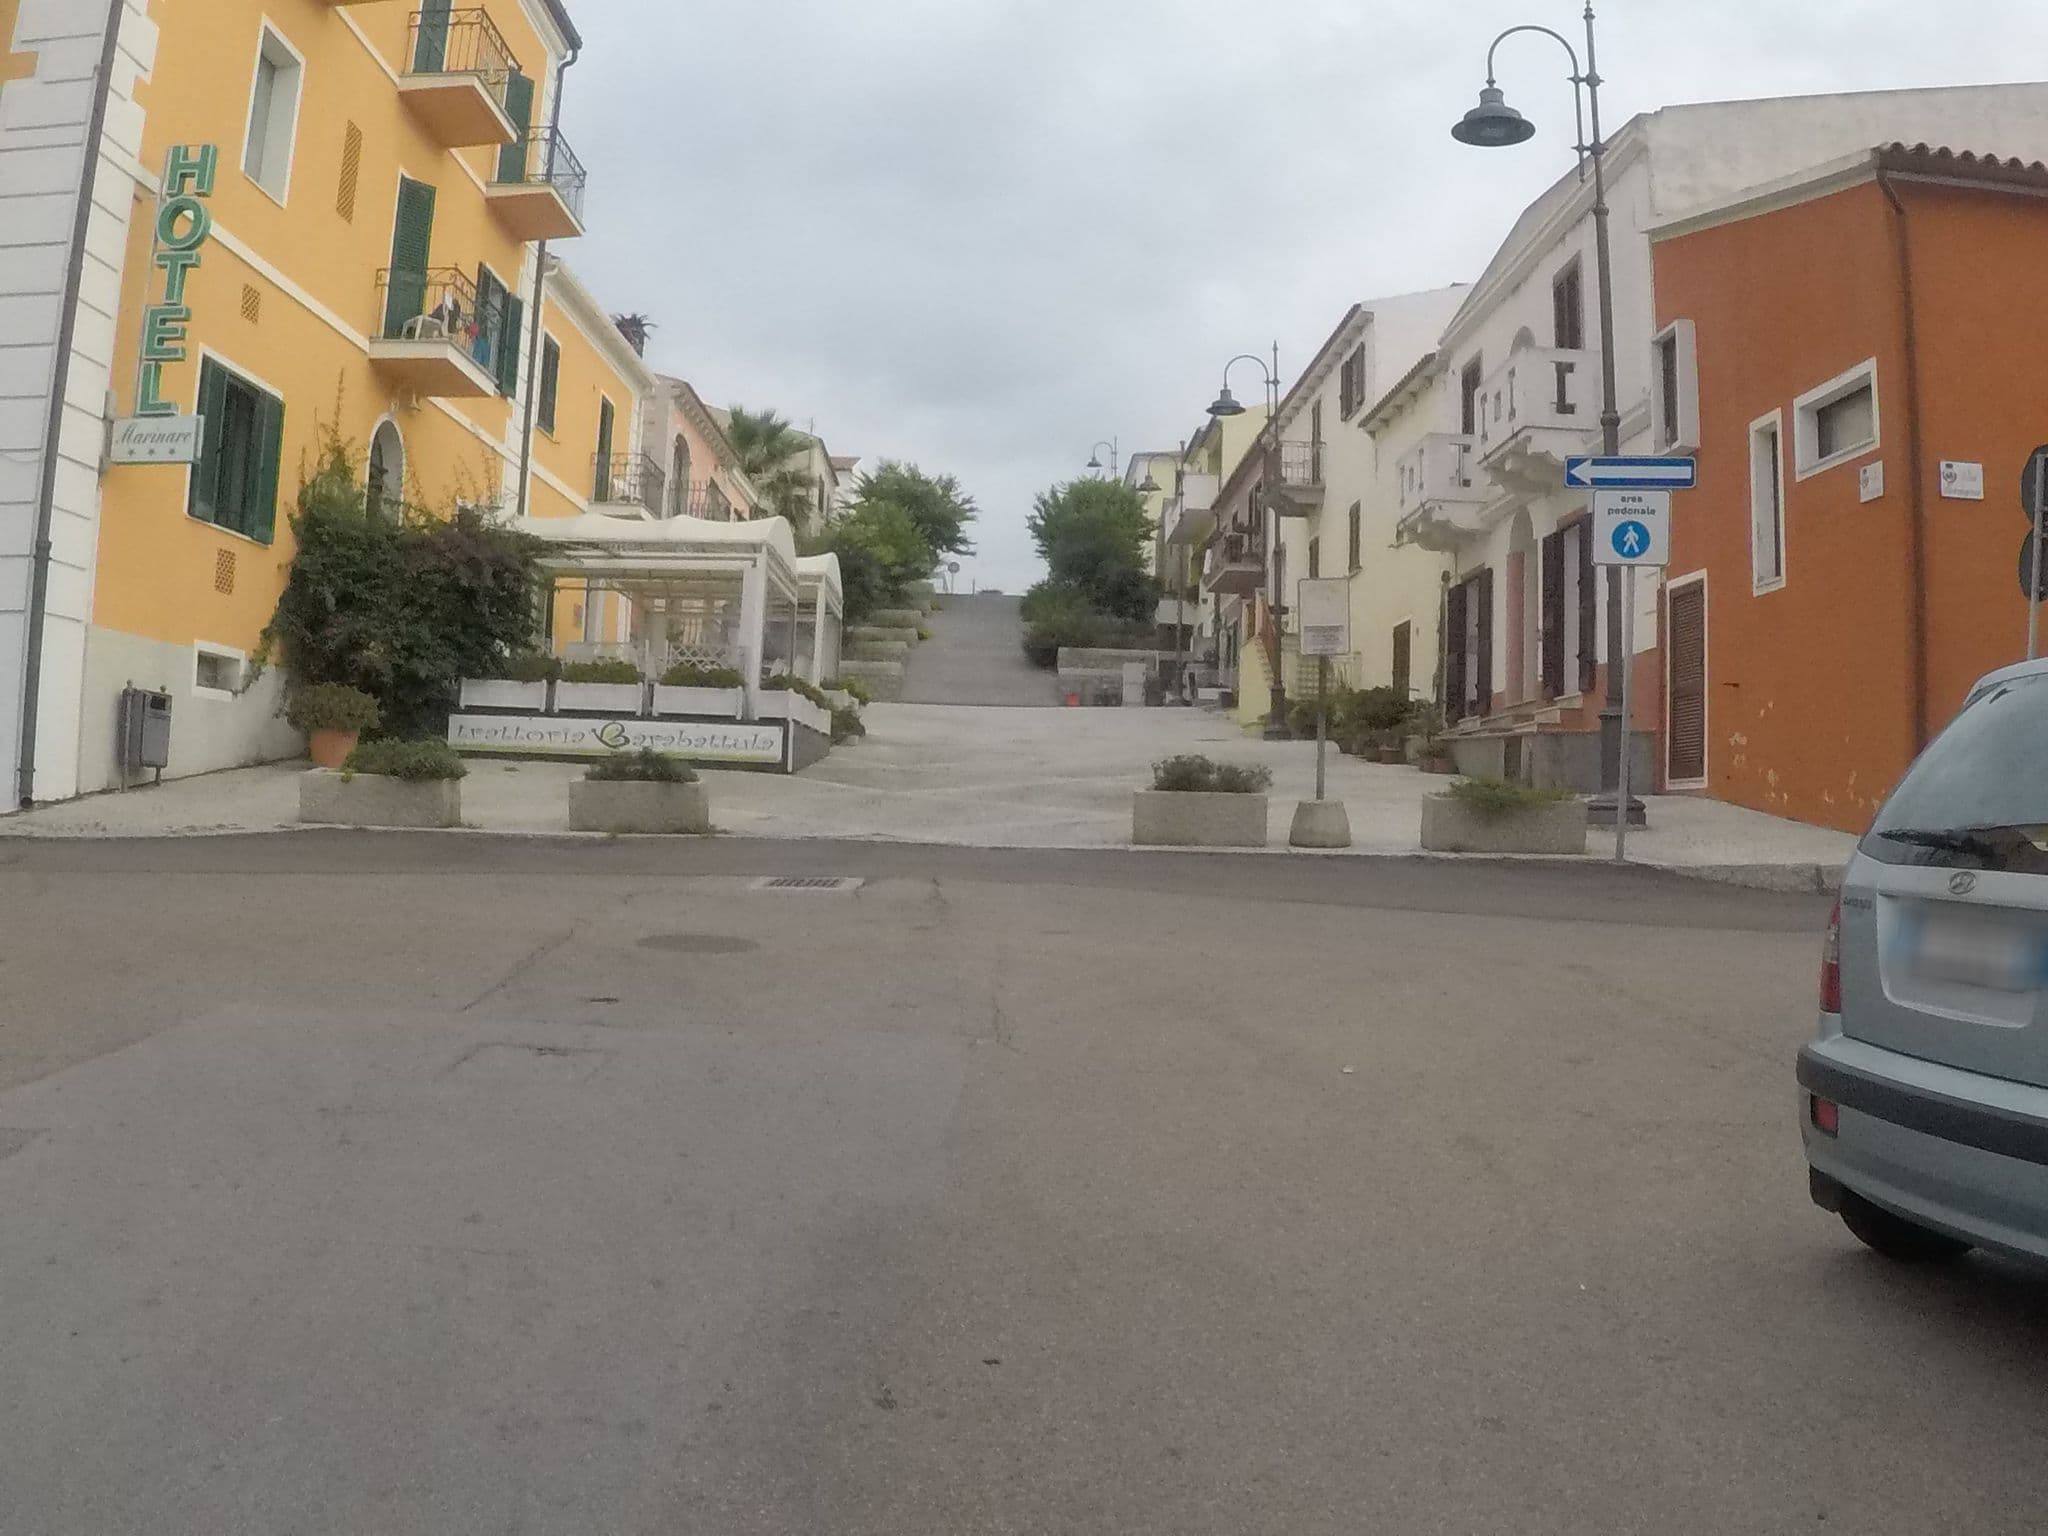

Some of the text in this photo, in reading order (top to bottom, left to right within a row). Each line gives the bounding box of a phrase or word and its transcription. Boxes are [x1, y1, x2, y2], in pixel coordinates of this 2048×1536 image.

[137, 144, 217, 415] HOTEL
[1620, 495, 1643, 504] area
[1607, 506, 1656, 516] pedonale
[457, 724, 585, 744] trattoria
